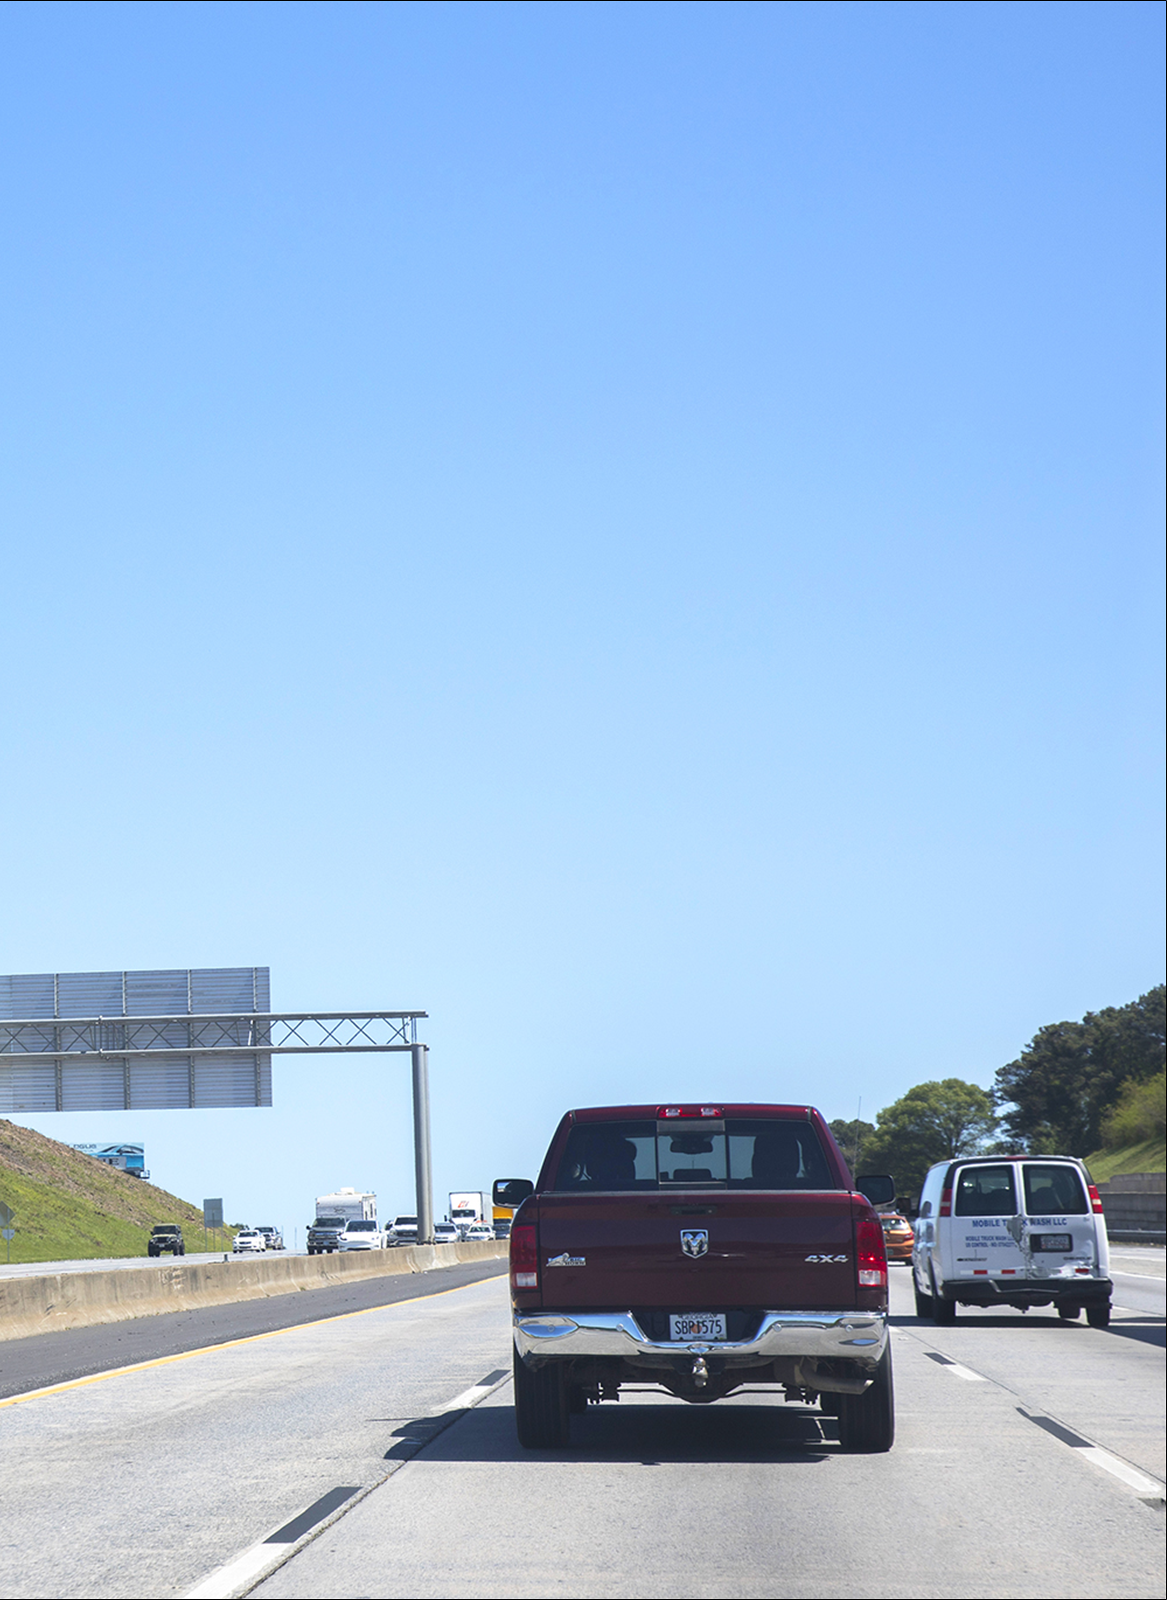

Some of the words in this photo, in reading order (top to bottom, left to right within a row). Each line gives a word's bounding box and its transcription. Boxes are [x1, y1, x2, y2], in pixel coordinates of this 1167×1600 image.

[972, 1219, 1000, 1228] MOBILE
[1053, 1218, 1068, 1226] LLC
[804, 1254, 849, 1263] 4X4
